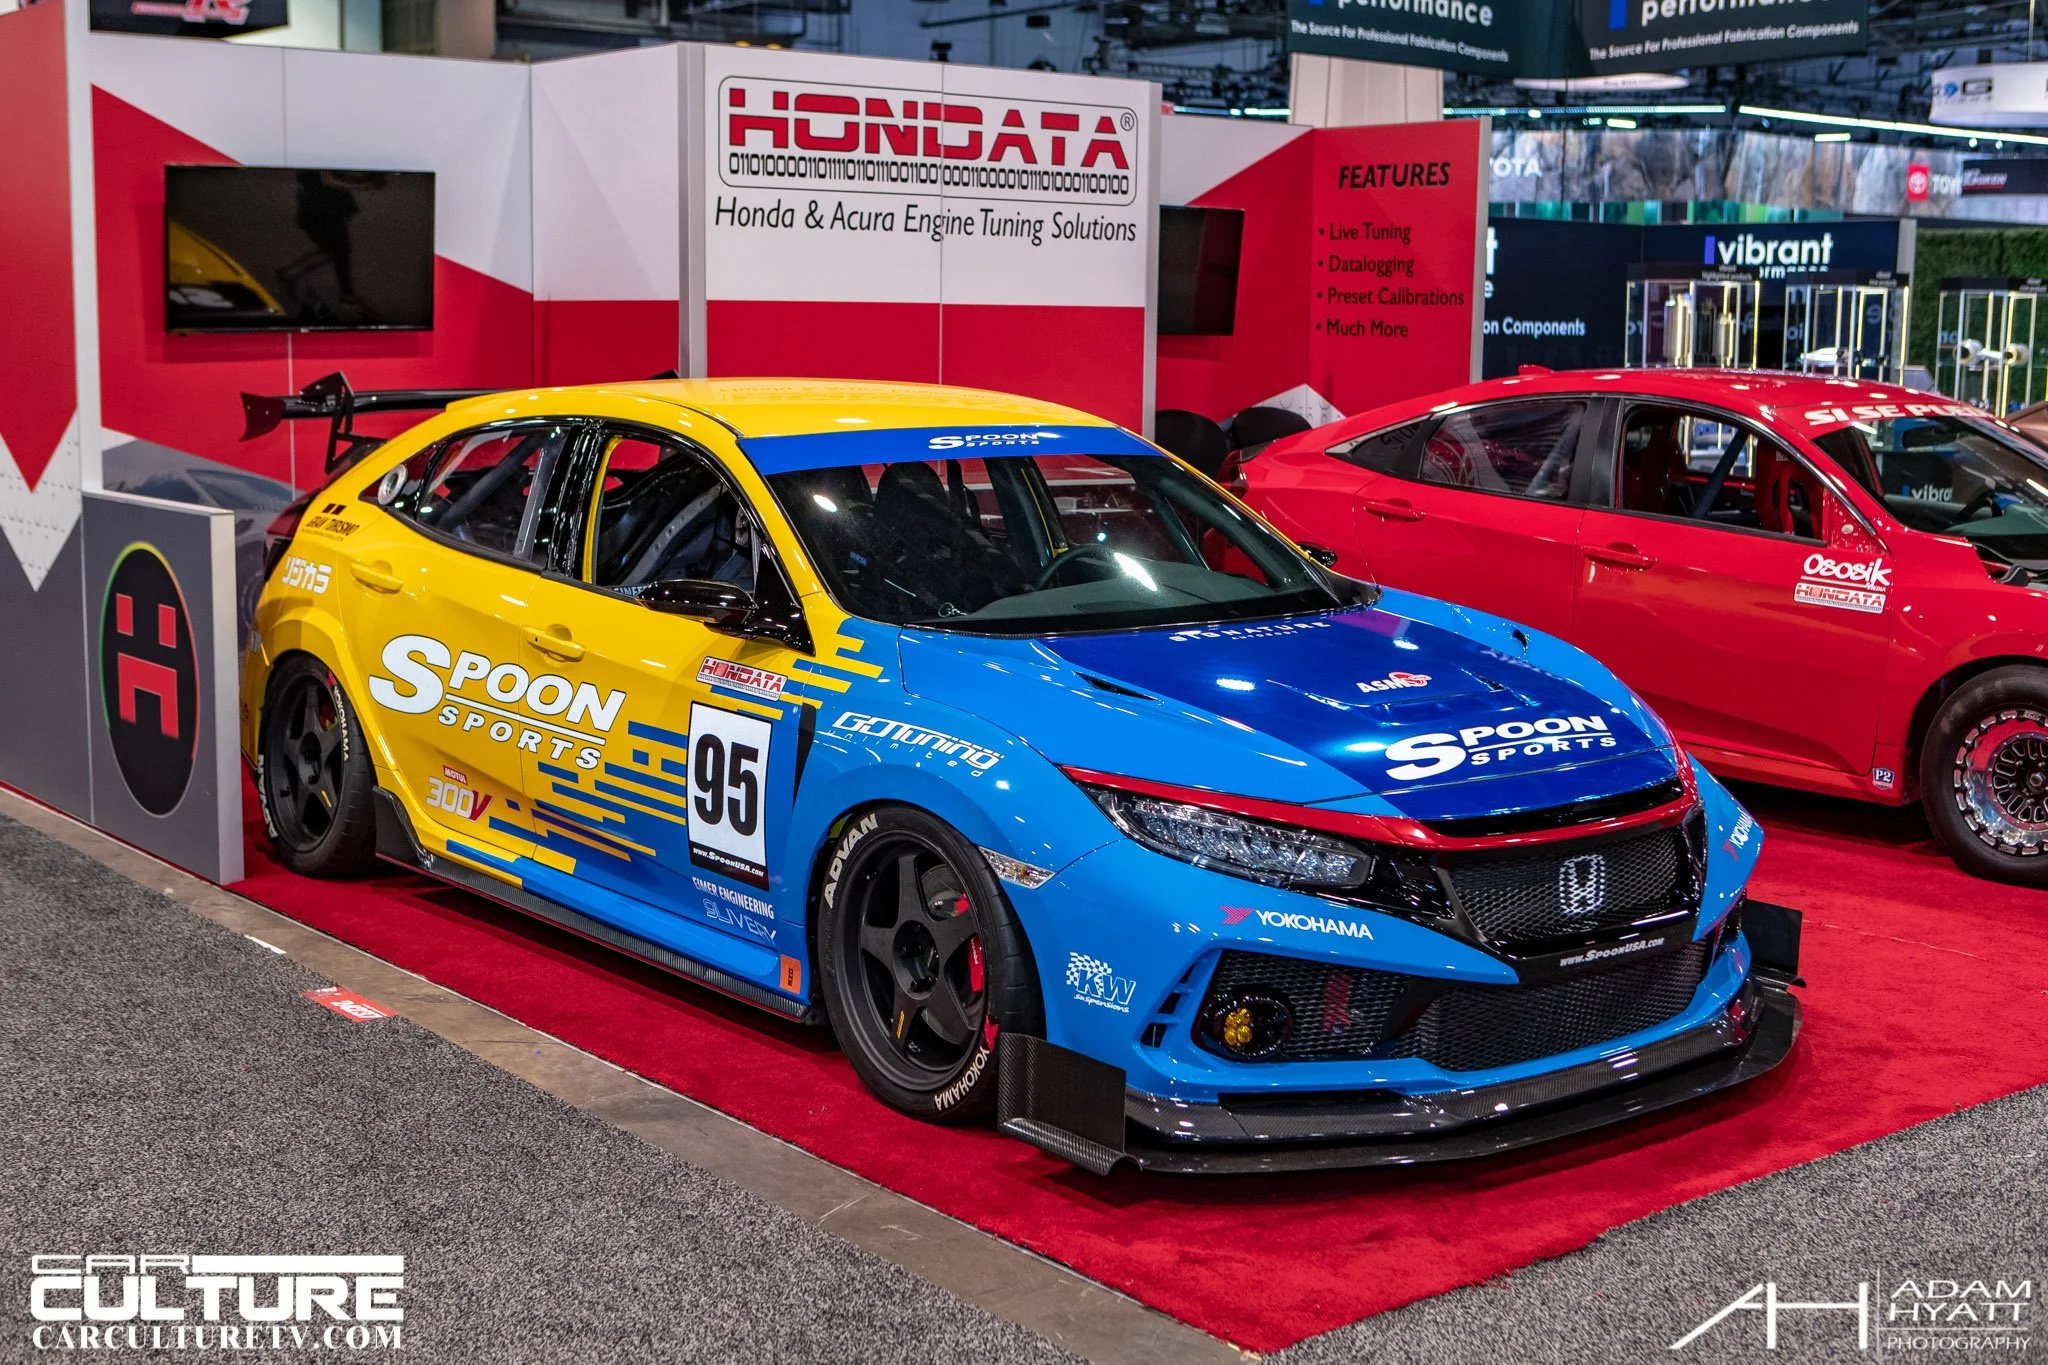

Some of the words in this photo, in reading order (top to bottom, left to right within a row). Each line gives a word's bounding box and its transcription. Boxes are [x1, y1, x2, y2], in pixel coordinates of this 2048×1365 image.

[1291, 19, 1307, 34] The
[1308, 21, 1341, 38] Source
[1342, 23, 1357, 40] For
[1357, 26, 1409, 46] Professional
[1410, 33, 1457, 54] Fabrication
[1458, 41, 1509, 63] Components
[1589, 47, 1607, 61] The
[1608, 42, 1643, 58] Source
[1644, 40, 1661, 55] For
[1662, 30, 1723, 52] Professional
[1724, 25, 1785, 44] Fabrication
[1787, 20, 1860, 42] Components
[728, 87, 1130, 170] HONDATA
[1338, 162, 1451, 189] FEATURES
[715, 196, 795, 230] Honda
[805, 201, 825, 230] &
[830, 205, 895, 233] Acura
[904, 207, 975, 243] Engine
[979, 208, 1044, 247] Tuning
[1051, 211, 1137, 243] Solutions
[1329, 224, 1359, 241] Live
[1362, 222, 1411, 245] Tuning
[1328, 255, 1415, 277] Datalogging
[1717, 232, 1834, 266] vibrant
[1327, 286, 1374, 305] Preset
[1377, 287, 1465, 307] Calibrations
[1326, 318, 1366, 336] Much
[1370, 319, 1409, 338] More
[1502, 316, 1586, 339] Components
[928, 432, 1039, 450] SPOON
[1796, 584, 1882, 607] HONDATA
[368, 633, 628, 732] SPOON
[700, 658, 782, 693] HONDATA
[438, 705, 602, 770] SPORTS
[1385, 715, 1609, 781] SPOON
[1471, 736, 1617, 766] SPORTS
[444, 767, 468, 785] MOTUL
[694, 732, 760, 837] 95
[1875, 769, 1892, 783] P2
[426, 776, 493, 823] 300V
[823, 812, 879, 909] ADVAN
[718, 885, 775, 920] ENGINEERING
[1255, 909, 1375, 941] YOKOHAMA
[1076, 967, 1137, 1006] KW
[933, 1045, 990, 1112] YOKOHAMA
